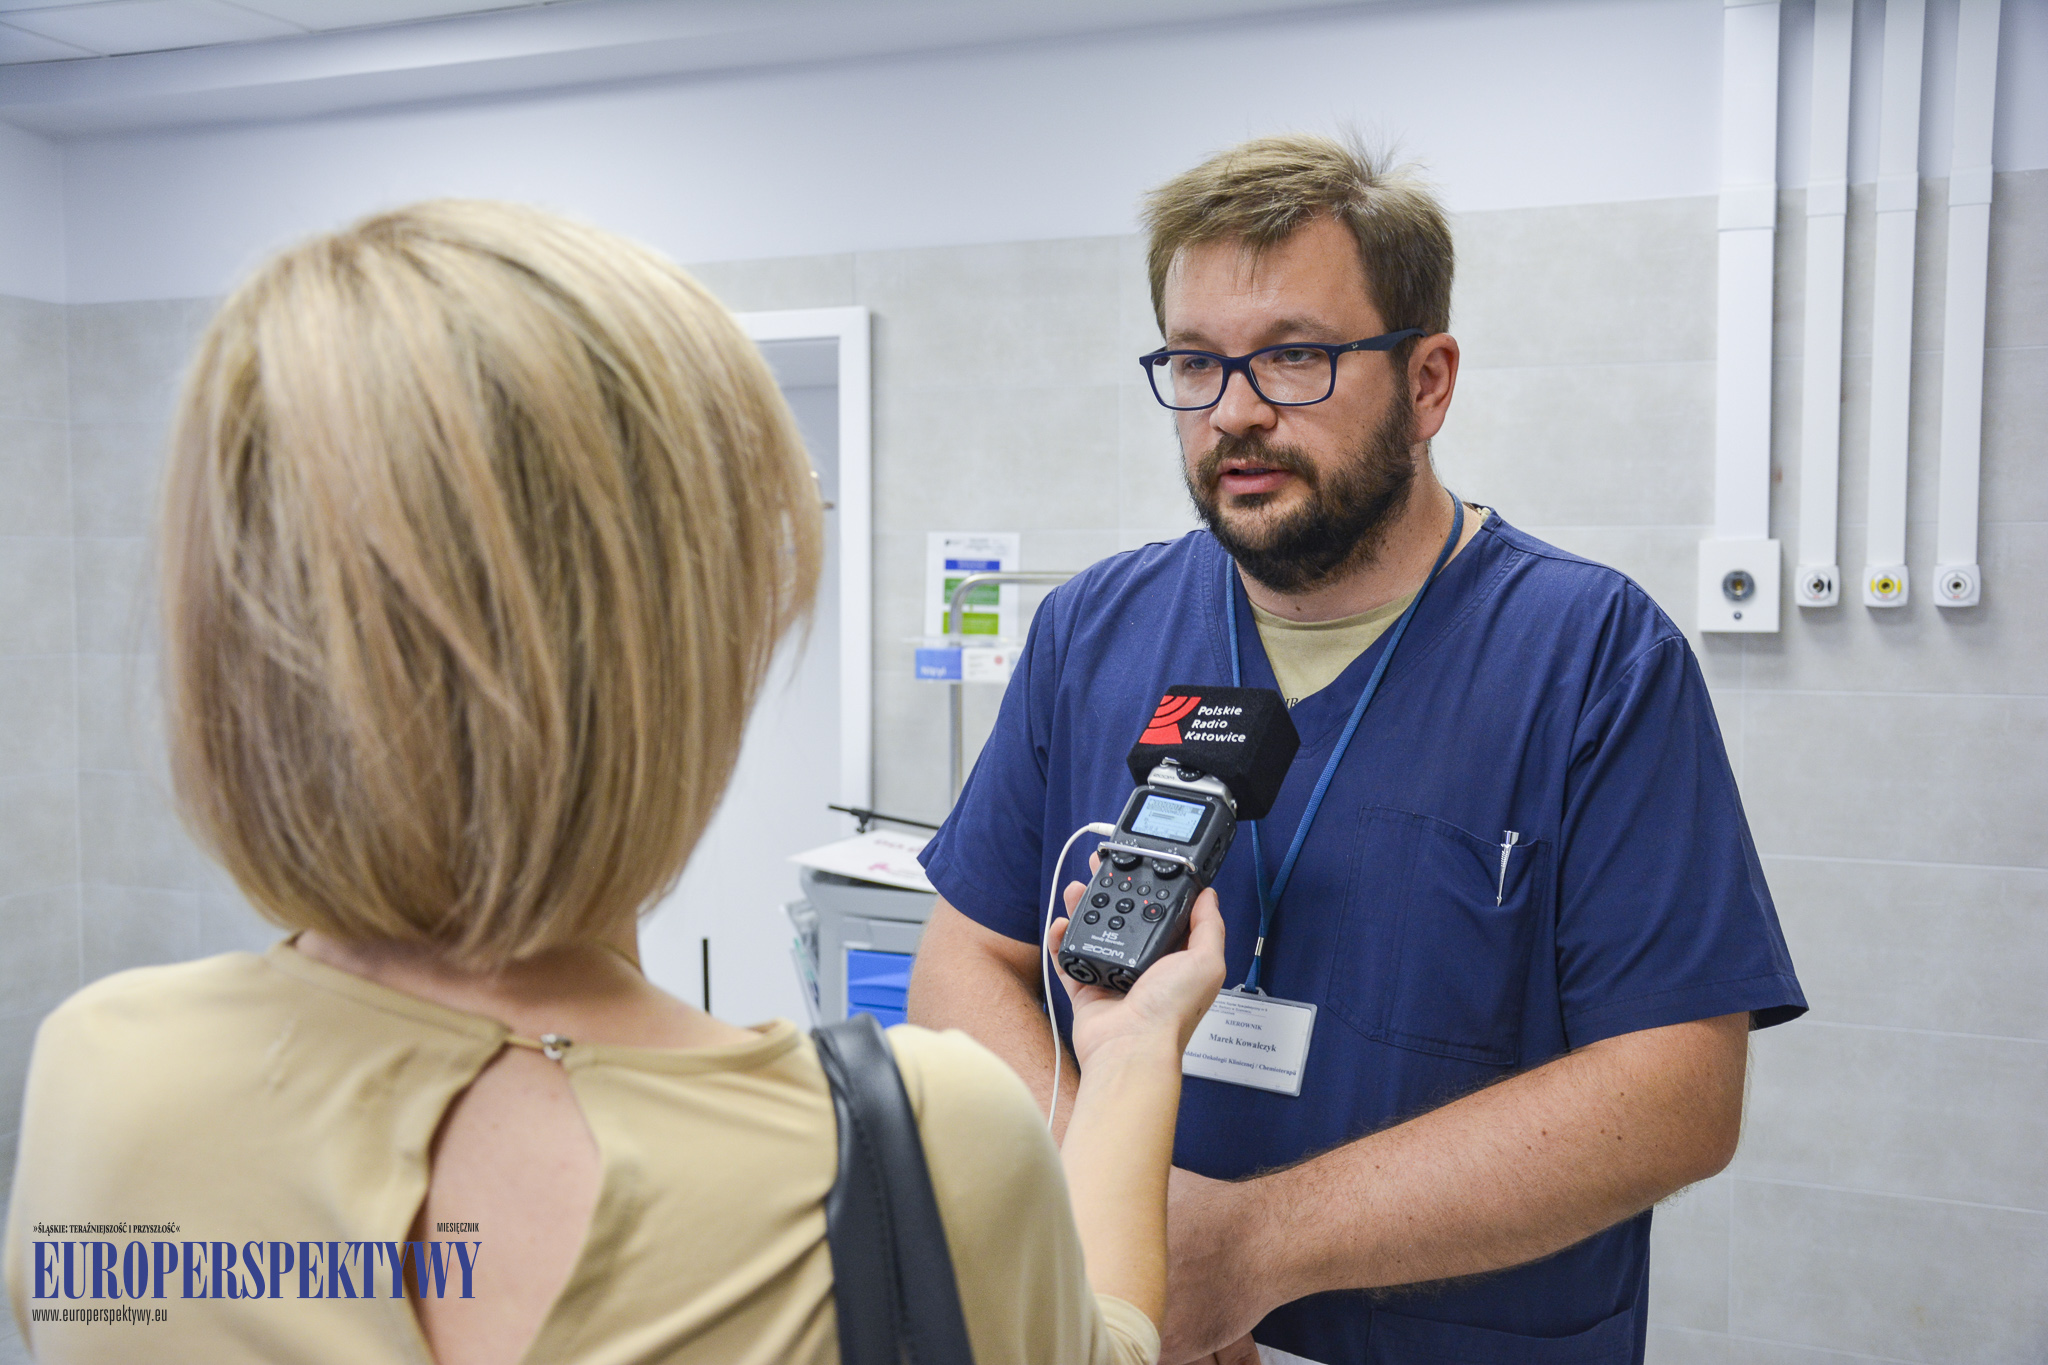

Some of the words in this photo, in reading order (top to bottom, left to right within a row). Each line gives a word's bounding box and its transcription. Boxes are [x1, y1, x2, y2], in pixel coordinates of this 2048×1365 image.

[1198, 706, 1242, 716] Polskie
[1191, 718, 1228, 729] Radio
[1184, 731, 1246, 743] Katowice
[1082, 943, 1125, 959] ZOOM
[1225, 1019, 1262, 1030] KIEROWNIK
[1209, 1033, 1234, 1045] Marek
[1235, 1038, 1277, 1053] Kowalczyk
